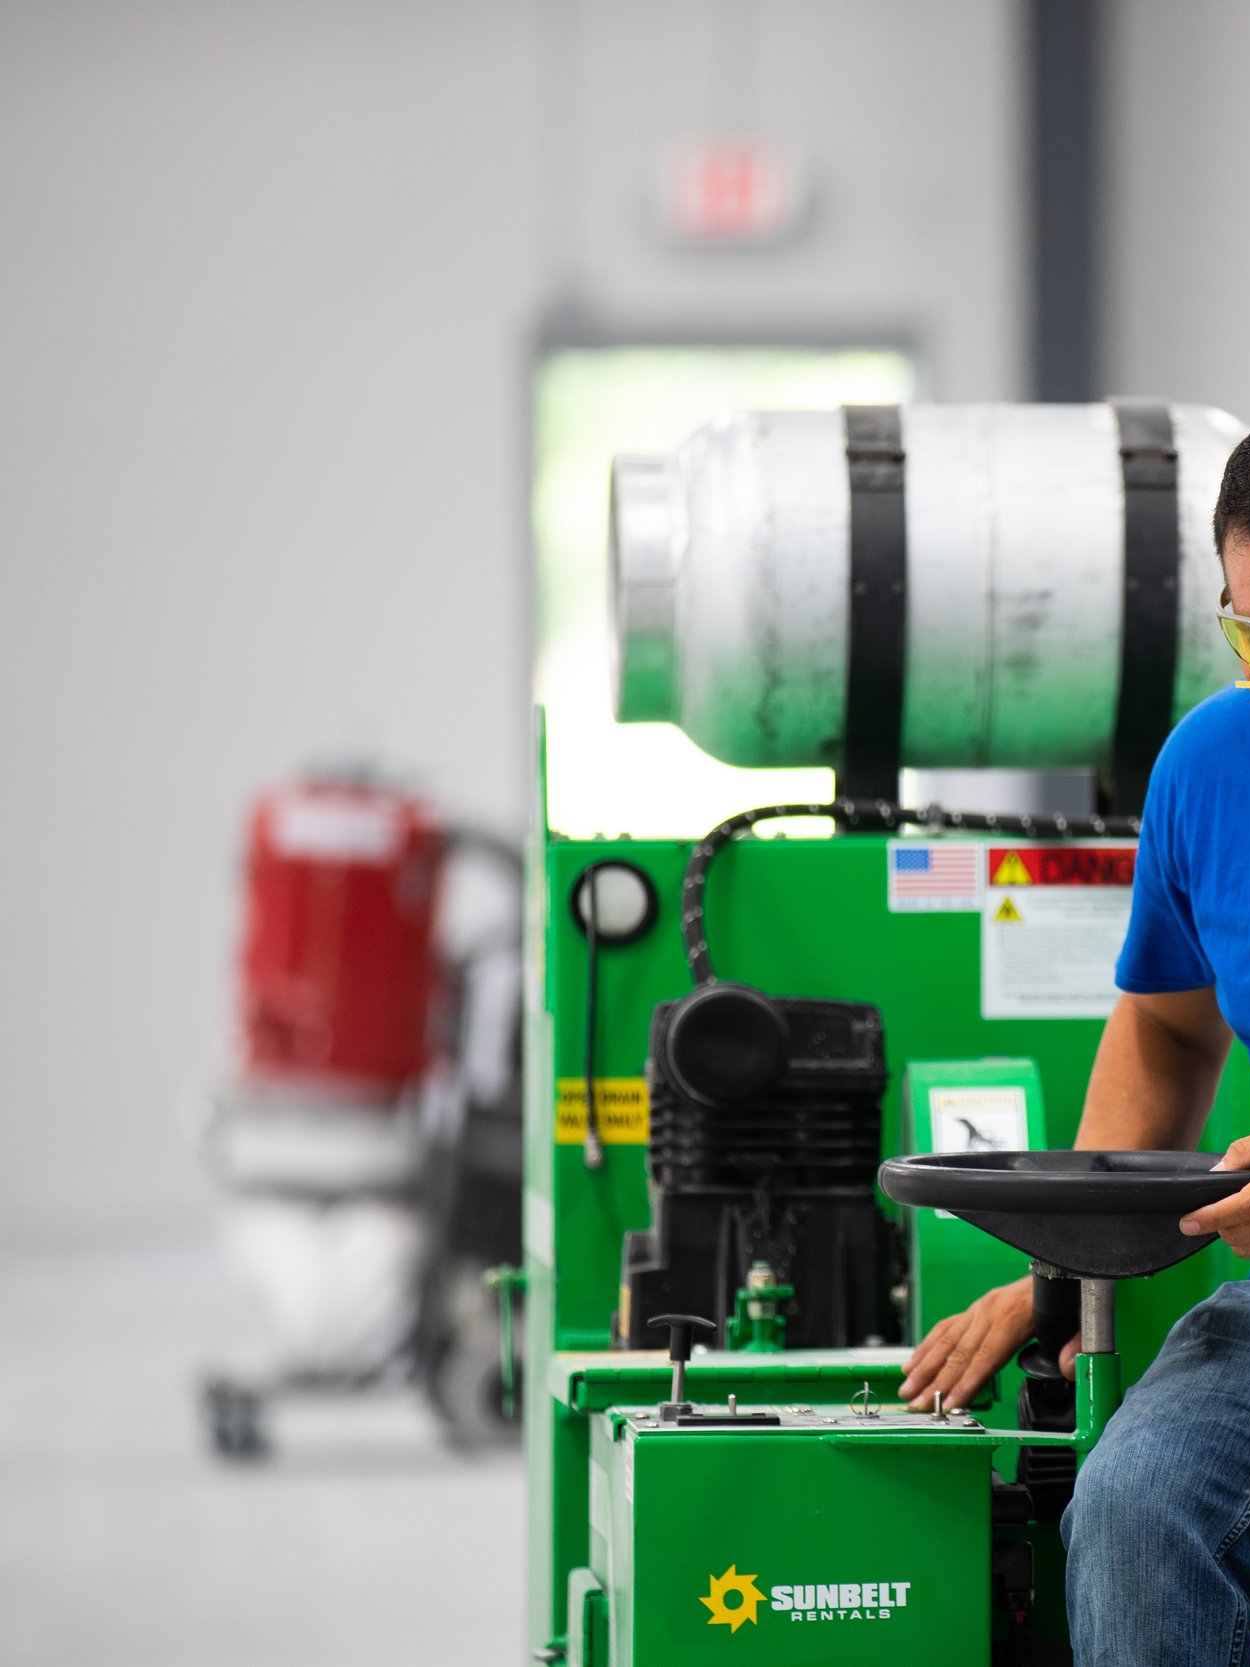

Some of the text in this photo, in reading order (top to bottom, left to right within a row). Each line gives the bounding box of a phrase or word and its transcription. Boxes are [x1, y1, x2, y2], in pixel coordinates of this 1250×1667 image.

[1041, 853, 1135, 885] DANG
[771, 1582, 911, 1611] SUNBELT
[791, 1609, 891, 1621] RENTALS
